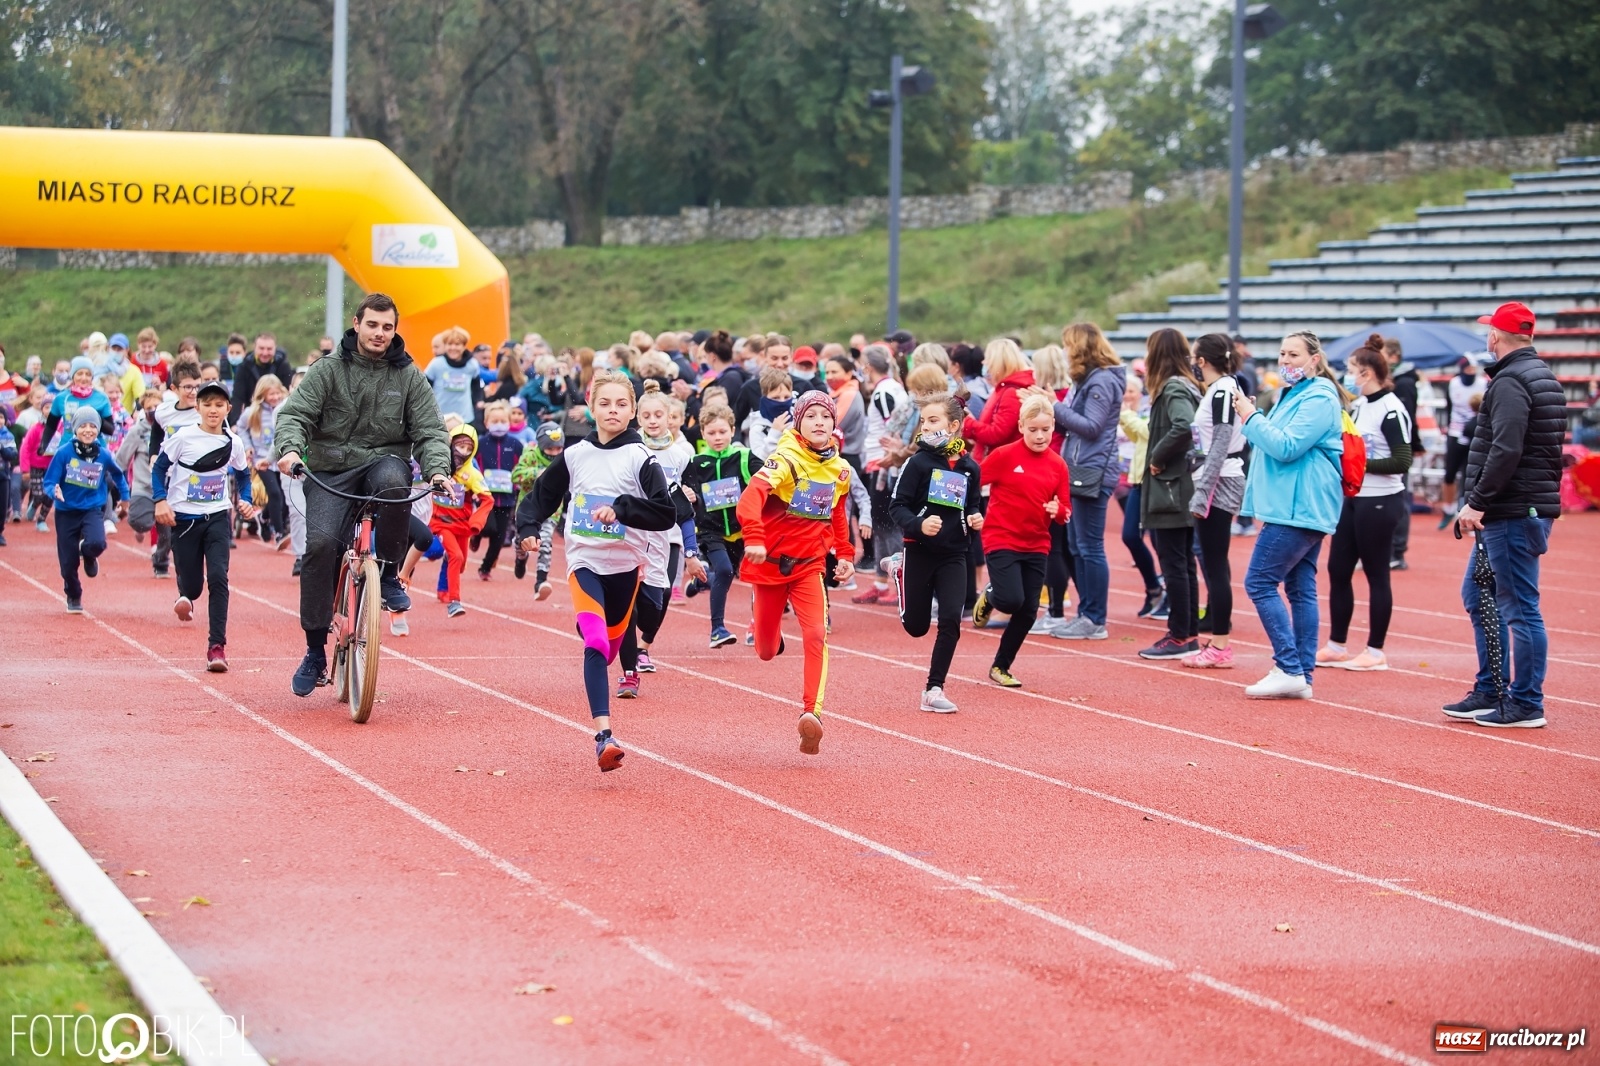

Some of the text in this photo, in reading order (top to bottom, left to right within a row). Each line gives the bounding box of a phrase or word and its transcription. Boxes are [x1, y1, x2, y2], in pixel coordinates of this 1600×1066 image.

[37, 180, 296, 207] MIASTO RACIBÓRZ
[601, 524, 620, 534] 026
